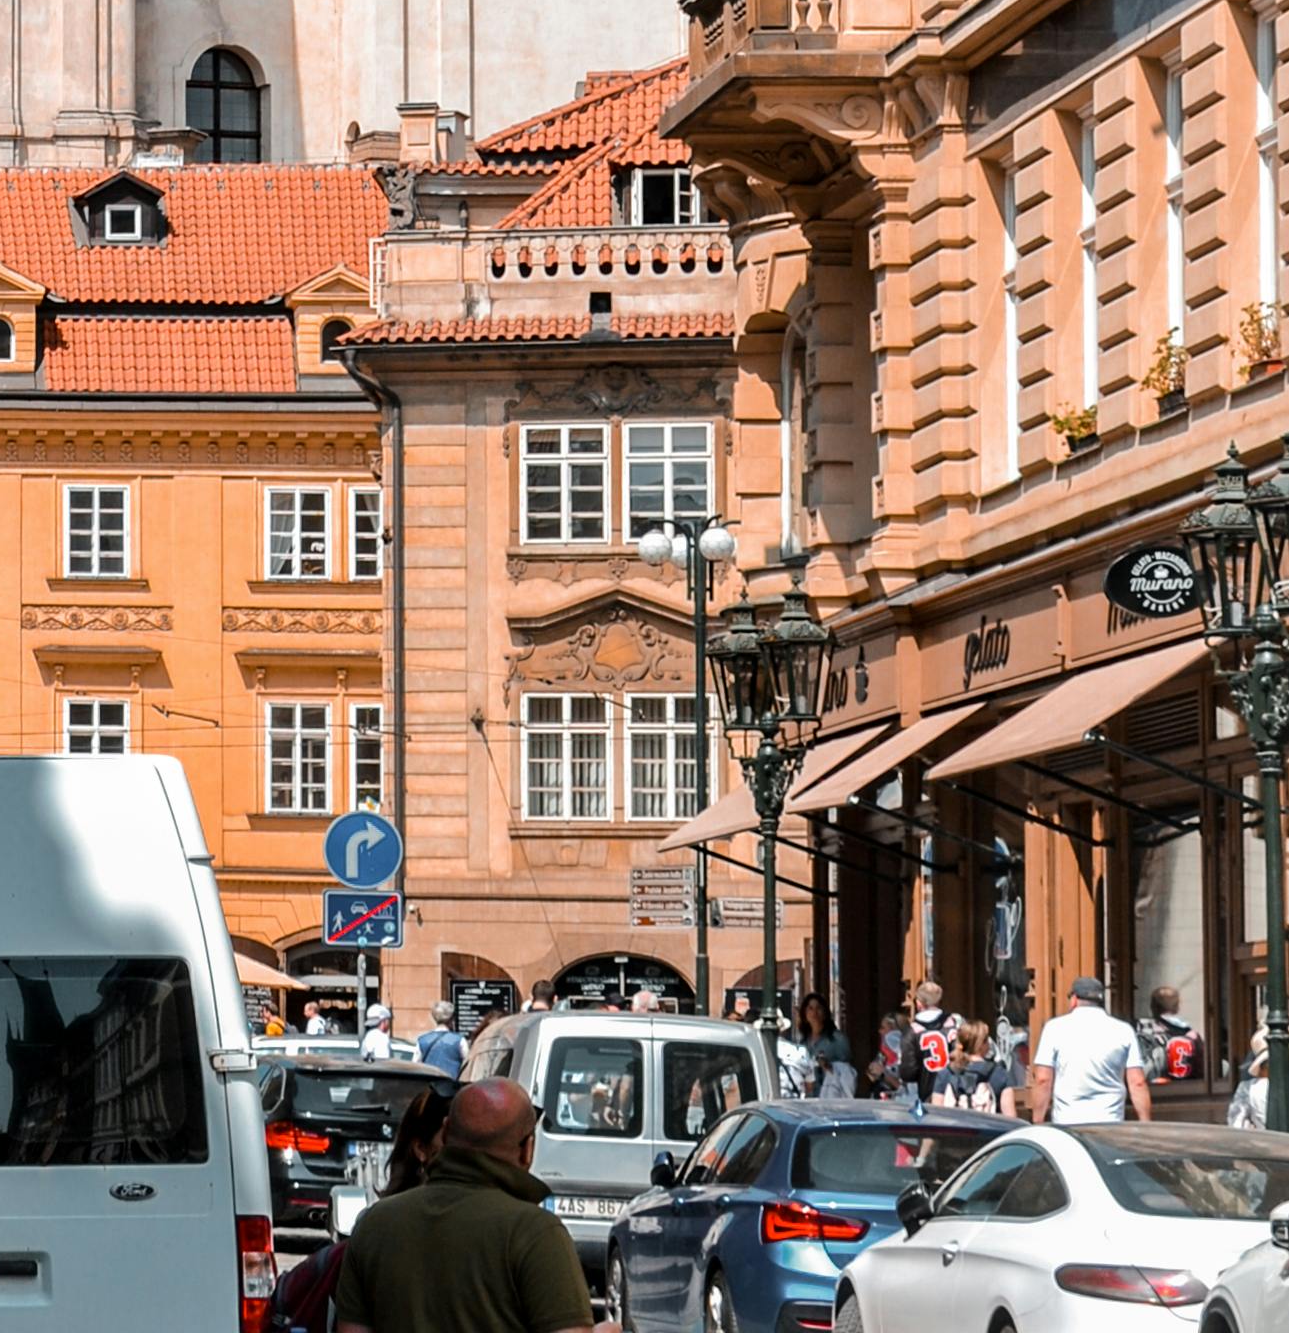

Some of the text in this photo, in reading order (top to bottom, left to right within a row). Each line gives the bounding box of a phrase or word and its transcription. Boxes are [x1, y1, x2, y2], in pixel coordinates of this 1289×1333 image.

[1130, 577, 1194, 592] Murano
[964, 614, 1010, 692] gelato
[920, 1032, 951, 1072] 3
[557, 1197, 585, 1213] 4AS
